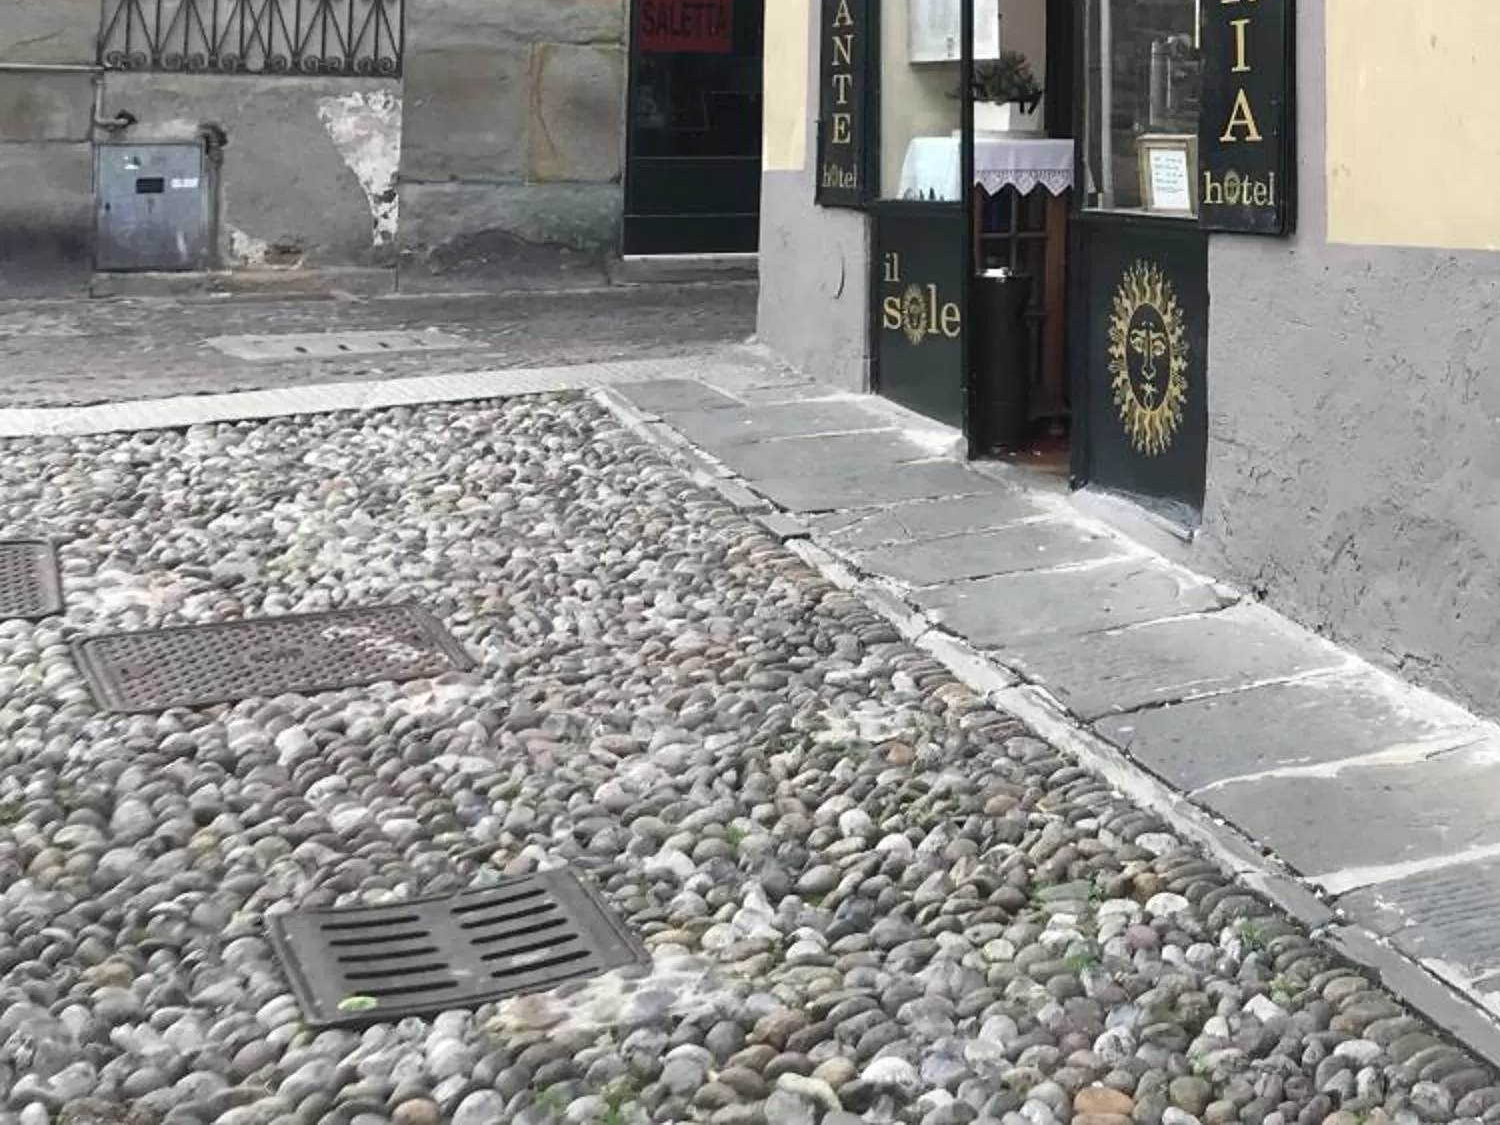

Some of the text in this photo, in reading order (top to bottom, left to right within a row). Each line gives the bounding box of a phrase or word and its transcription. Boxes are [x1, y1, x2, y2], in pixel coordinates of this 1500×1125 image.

[641, 0, 729, 38] SALETTA
[1203, 168, 1275, 206] hotel
[883, 251, 901, 282] il
[882, 282, 961, 346] sole
